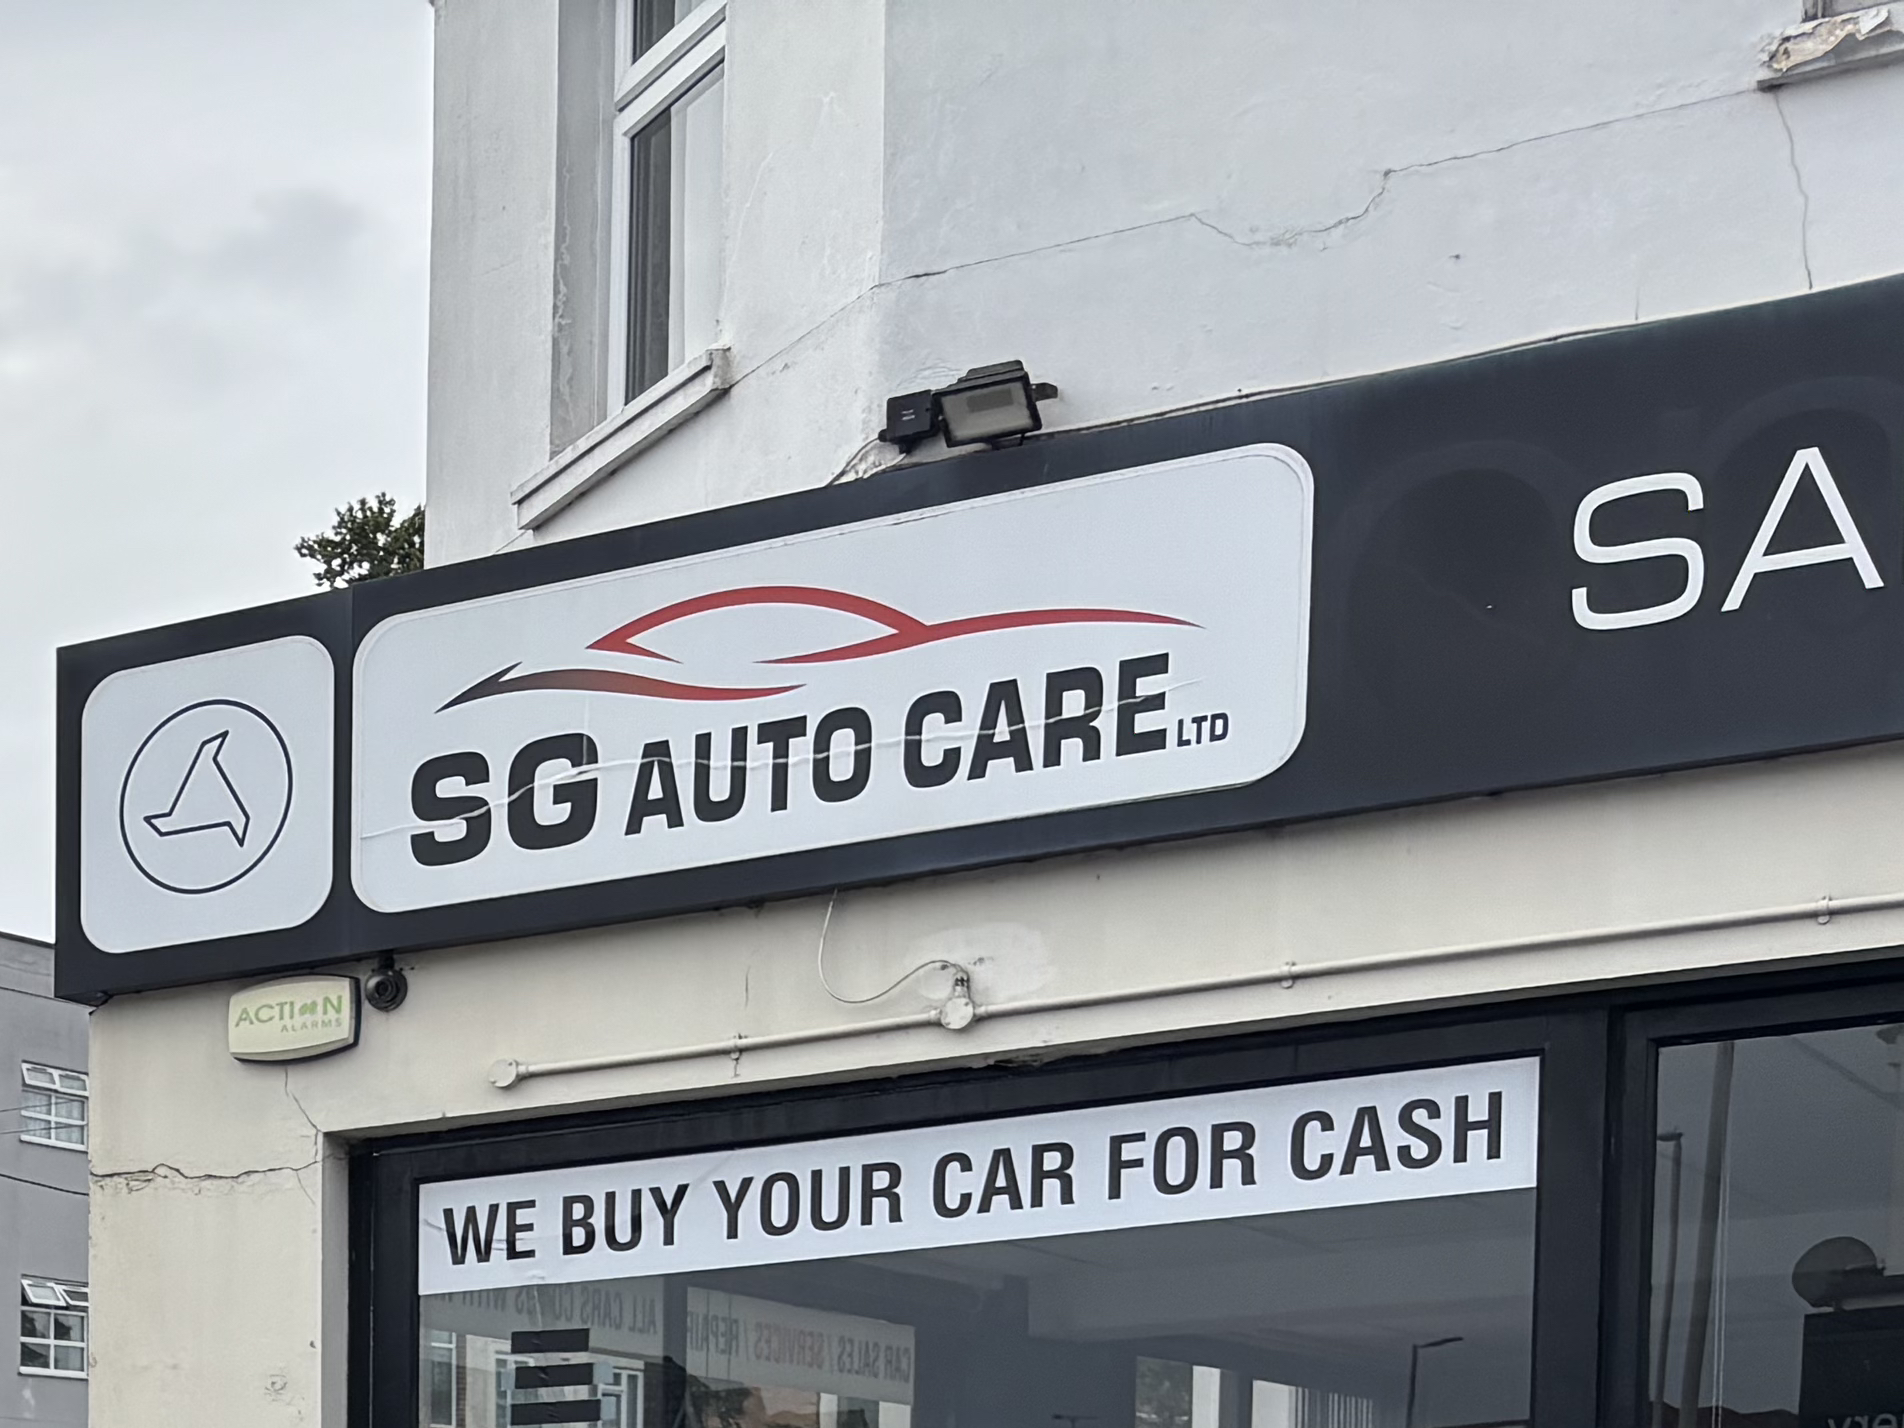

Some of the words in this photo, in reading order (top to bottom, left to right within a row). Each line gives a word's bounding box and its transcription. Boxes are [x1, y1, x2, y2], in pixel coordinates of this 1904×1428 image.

[1571, 446, 1885, 630] SA
[409, 732, 598, 867] SG
[624, 705, 873, 836] AUTO
[902, 651, 1171, 790] CARE
[1176, 712, 1229, 748] LTD
[280, 1017, 343, 1033] ALARMS
[442, 1199, 537, 1266] WE
[561, 1183, 691, 1257] BUY
[712, 1161, 904, 1241] YOUR
[932, 1142, 1074, 1218] CAR
[1107, 1121, 1258, 1200] FOR
[1291, 1090, 1504, 1181] CASH
